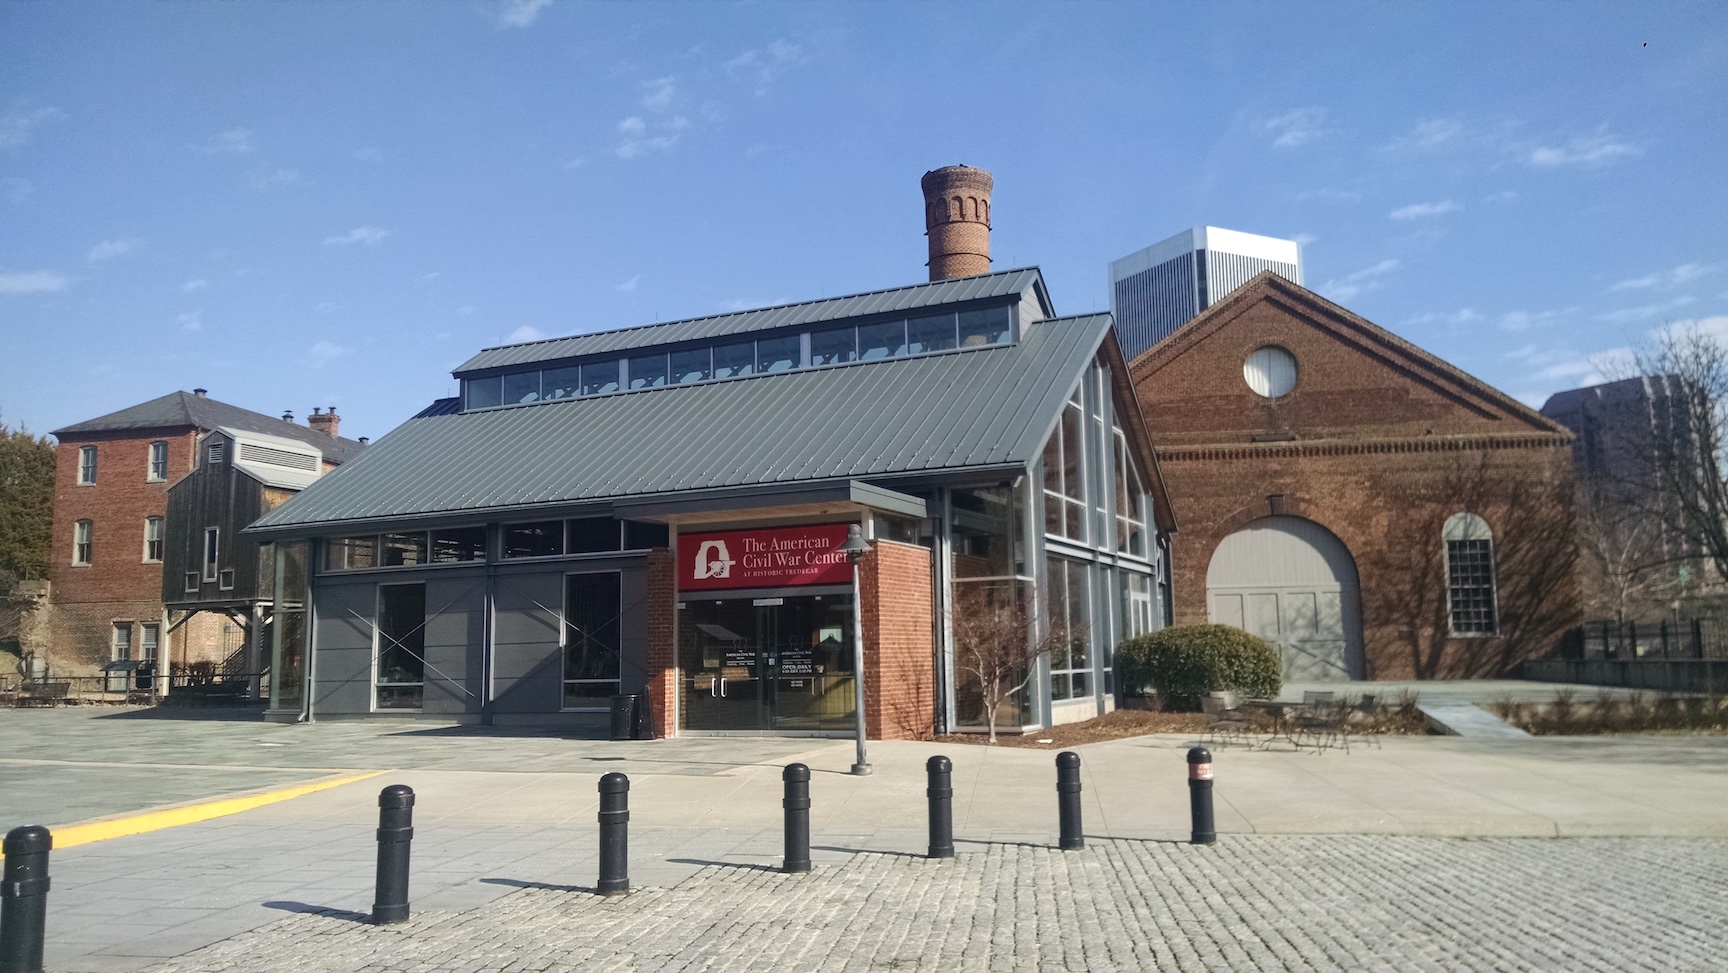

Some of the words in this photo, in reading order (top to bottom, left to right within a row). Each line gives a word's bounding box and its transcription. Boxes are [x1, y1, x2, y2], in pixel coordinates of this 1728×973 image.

[743, 538, 767, 552] The
[770, 535, 829, 551] American
[743, 553, 771, 568] Civil
[775, 552, 801, 566] War
[804, 551, 848, 565] Center
